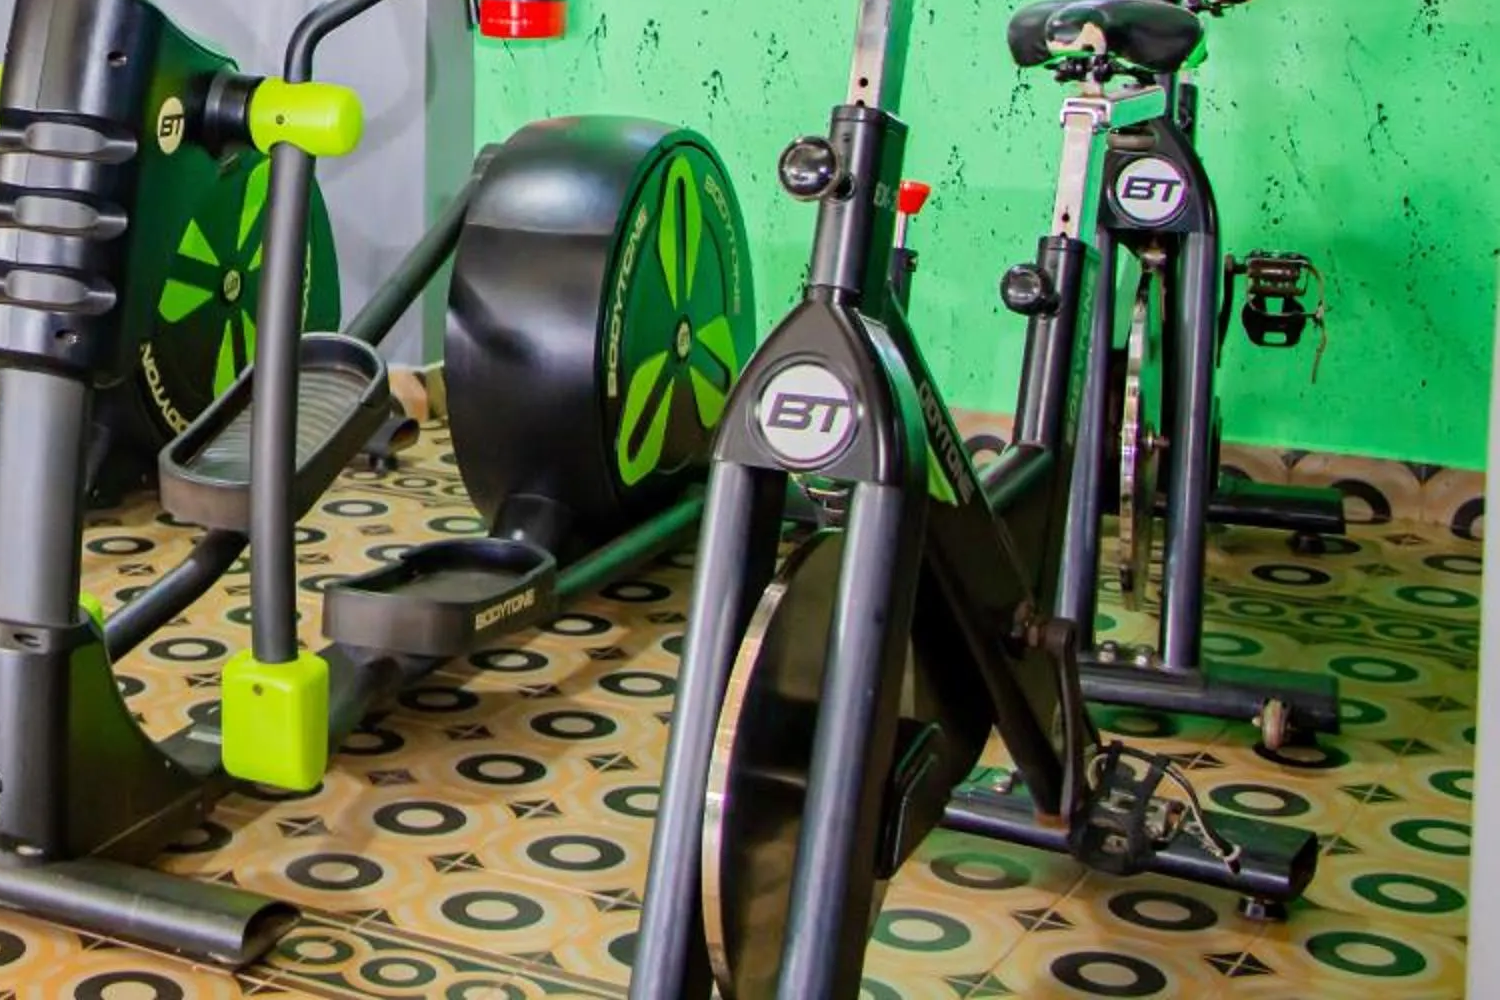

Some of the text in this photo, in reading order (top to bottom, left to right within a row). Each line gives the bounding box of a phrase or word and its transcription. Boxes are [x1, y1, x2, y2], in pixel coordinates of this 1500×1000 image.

[1121, 175, 1182, 203] BT
[607, 203, 649, 398] BODYTONE
[140, 342, 191, 434] ODYTON
[766, 391, 850, 433] BT
[919, 380, 976, 505] ODYTONE
[475, 587, 536, 631] BODYTONE
